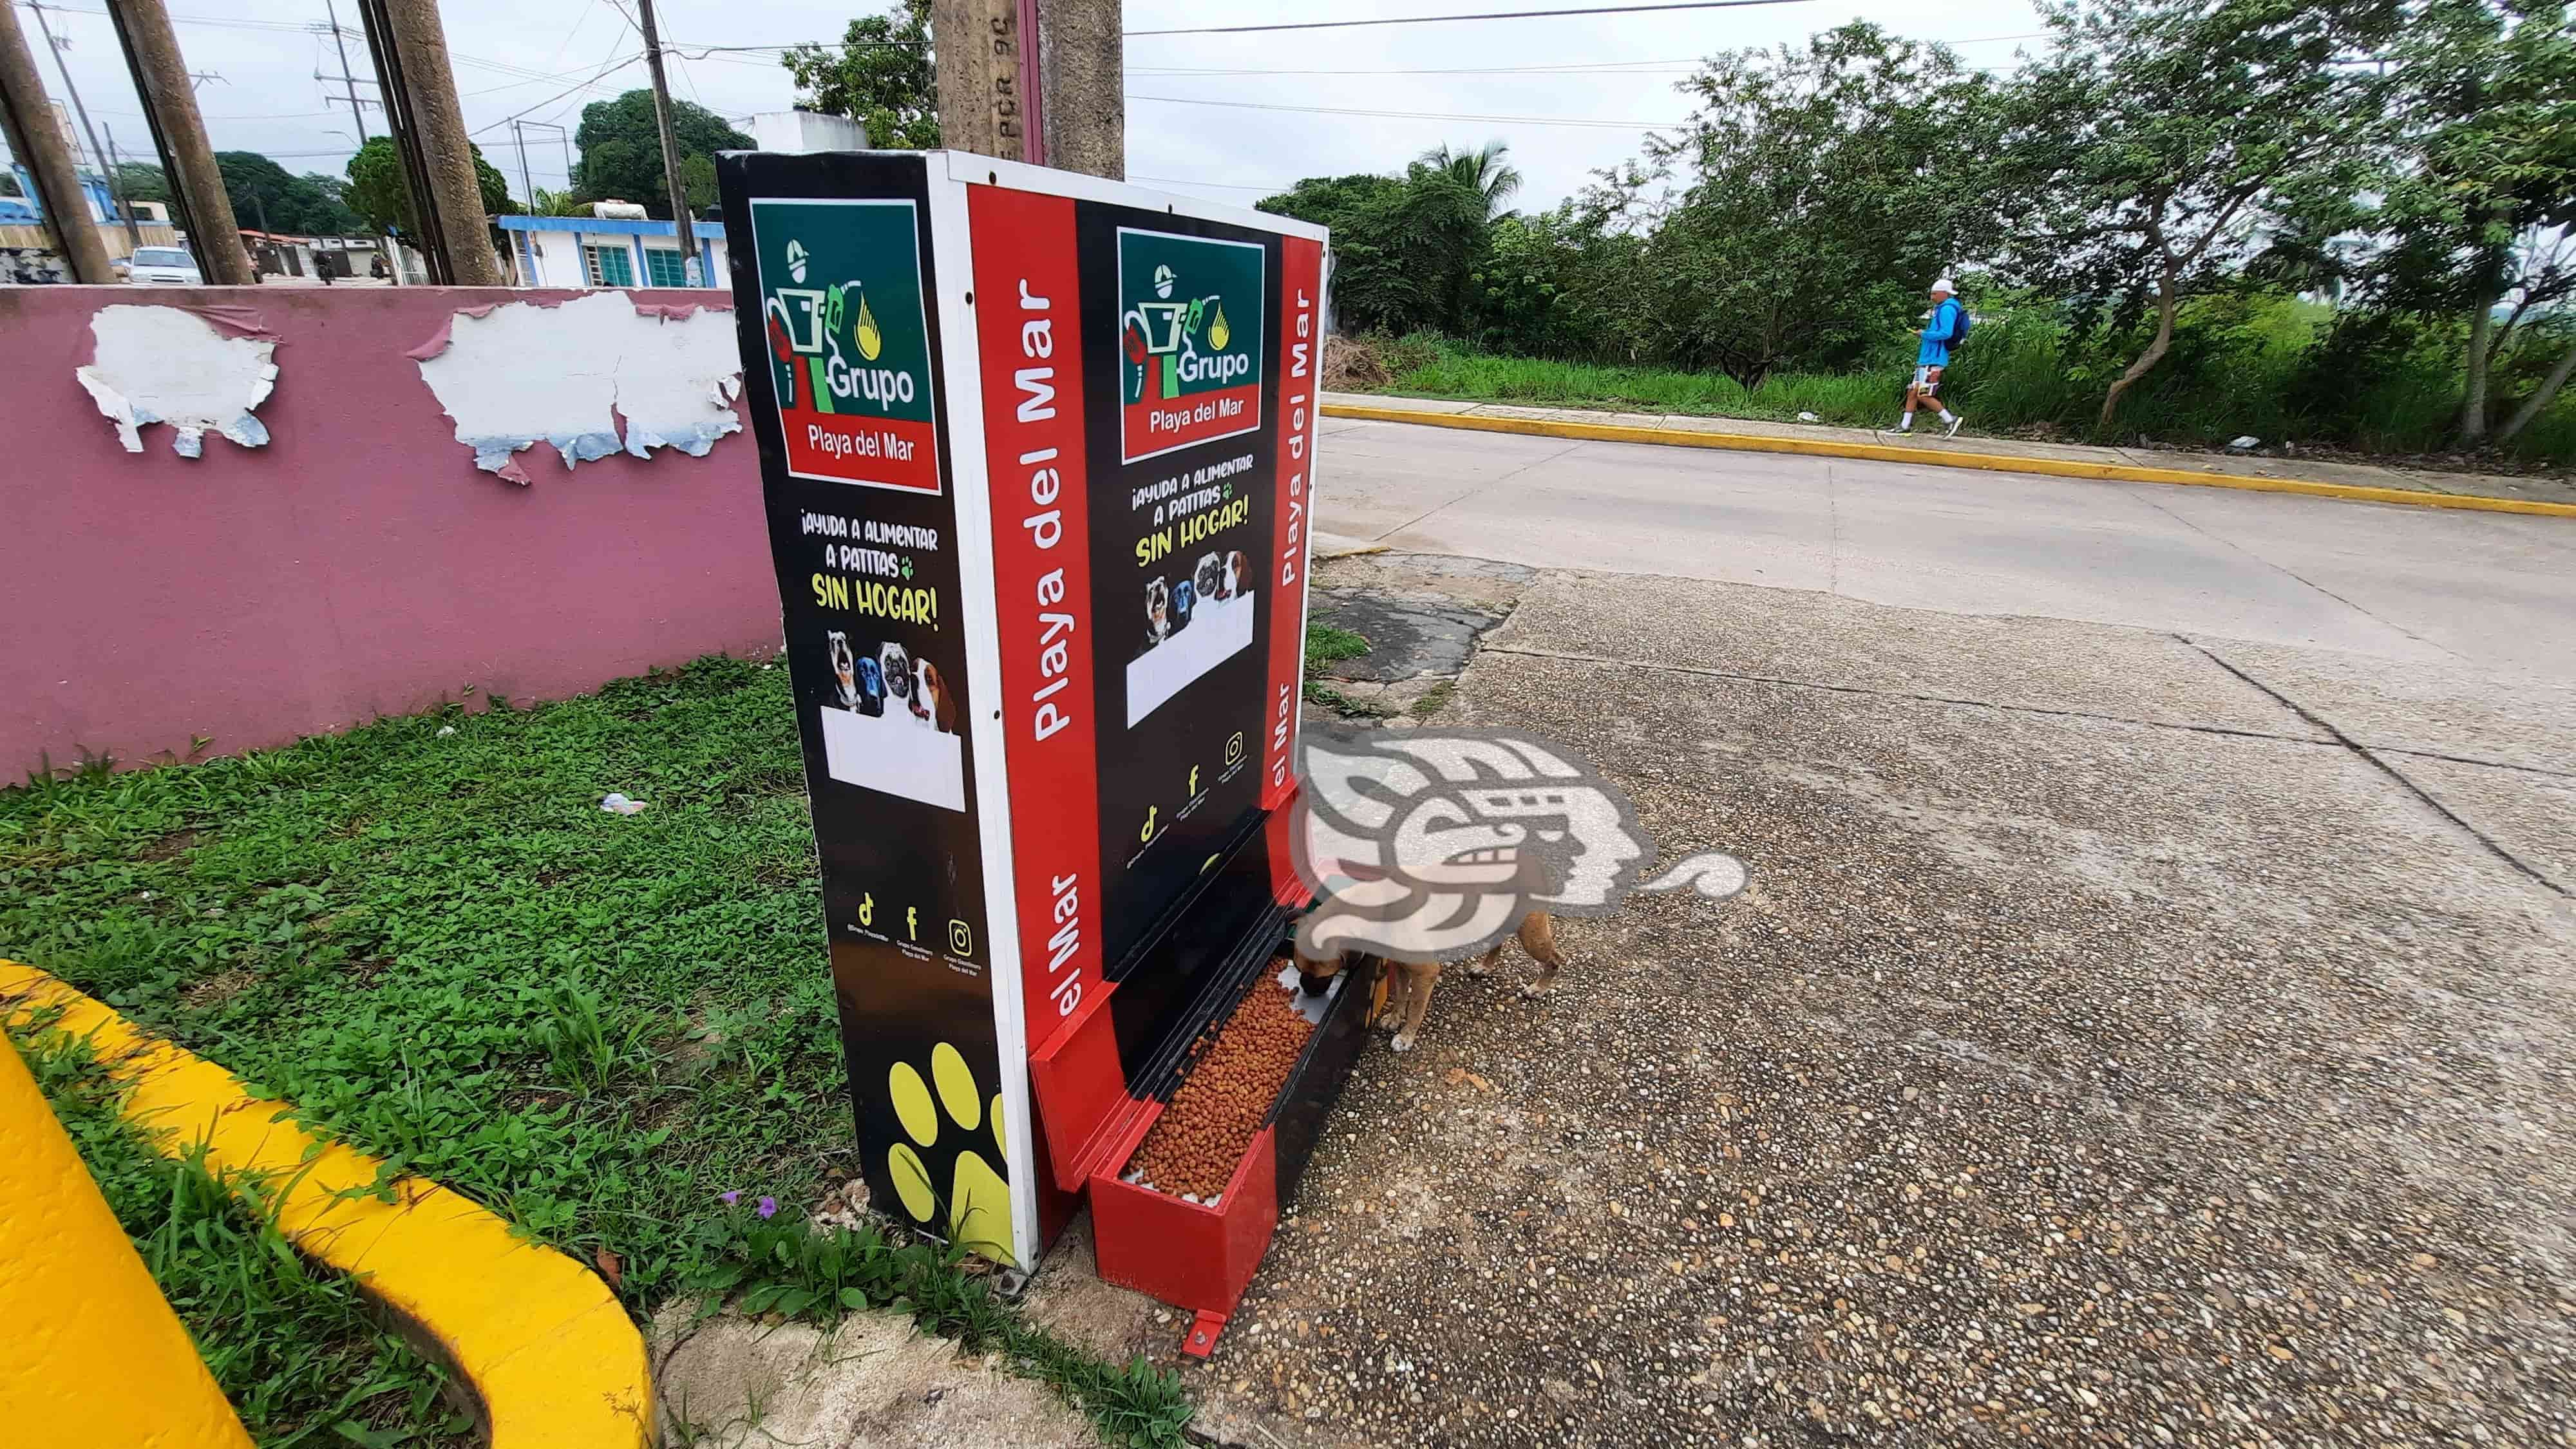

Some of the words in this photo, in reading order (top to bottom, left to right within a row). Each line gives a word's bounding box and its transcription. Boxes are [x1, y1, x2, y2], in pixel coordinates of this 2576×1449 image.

[1014, 278, 1057, 423] Mar
[1291, 288, 1309, 377] Mar
[826, 354, 914, 411] Grupo
[1177, 351, 1249, 384] Grupo
[808, 424, 852, 459] Playa
[855, 430, 880, 457] del
[884, 432, 914, 462] Mar
[1150, 410, 1190, 433] Playa
[1195, 400, 1215, 422] del
[1220, 397, 1244, 418] Mar
[1289, 395, 1305, 459] del
[1019, 448, 1062, 549] del
[1132, 477, 1177, 511] ¡AYUDA
[1182, 474, 1189, 491] A
[1194, 454, 1253, 486] ALIMENTAR
[1154, 505, 1163, 527] A
[1169, 485, 1220, 521] PATITAS
[800, 508, 847, 538] ¡AYUDA
[851, 519, 860, 540] A
[866, 520, 938, 551] ALIMENTAR
[1135, 526, 1173, 567] SIN
[1180, 494, 1249, 548] HOGAR!
[1282, 472, 1302, 587] Playa
[826, 544, 836, 568] A
[840, 545, 899, 578] PATITAS
[812, 573, 849, 611] SIN
[856, 580, 939, 631] HOGAR!
[1033, 567, 1075, 741] Playa
[1274, 683, 1290, 751] Mar
[1048, 873, 1080, 973] Mar
